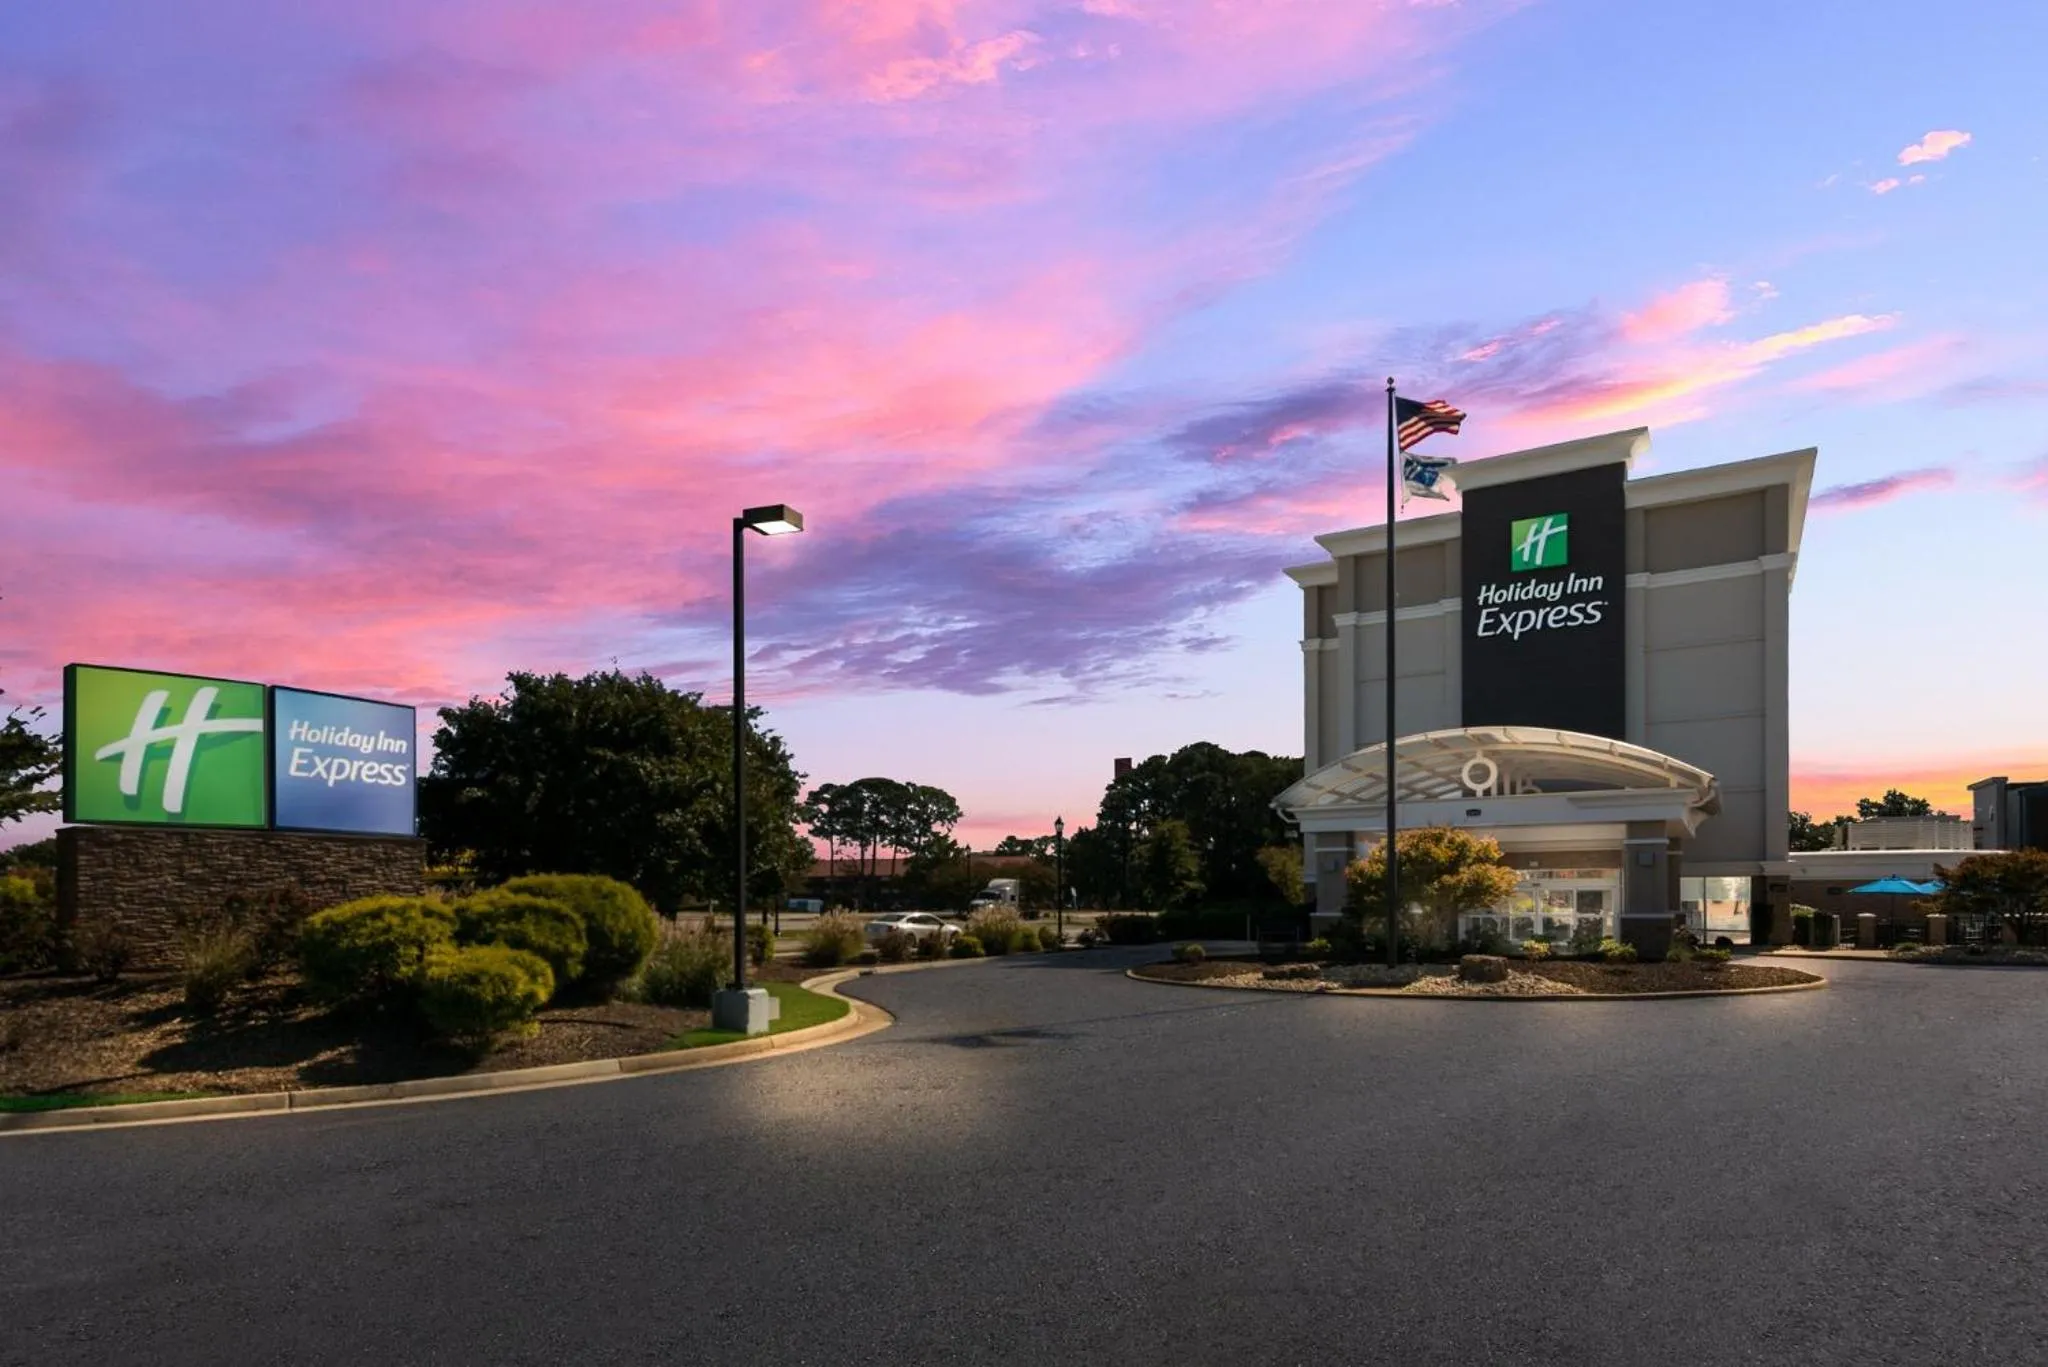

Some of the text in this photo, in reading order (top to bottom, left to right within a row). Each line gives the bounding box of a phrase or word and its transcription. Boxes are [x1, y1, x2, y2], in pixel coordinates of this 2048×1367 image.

[1477, 572, 1604, 605] Holiday Inn
[1477, 601, 1603, 641] Express
[288, 719, 408, 754] Holiday Inn
[288, 746, 407, 788] Express
